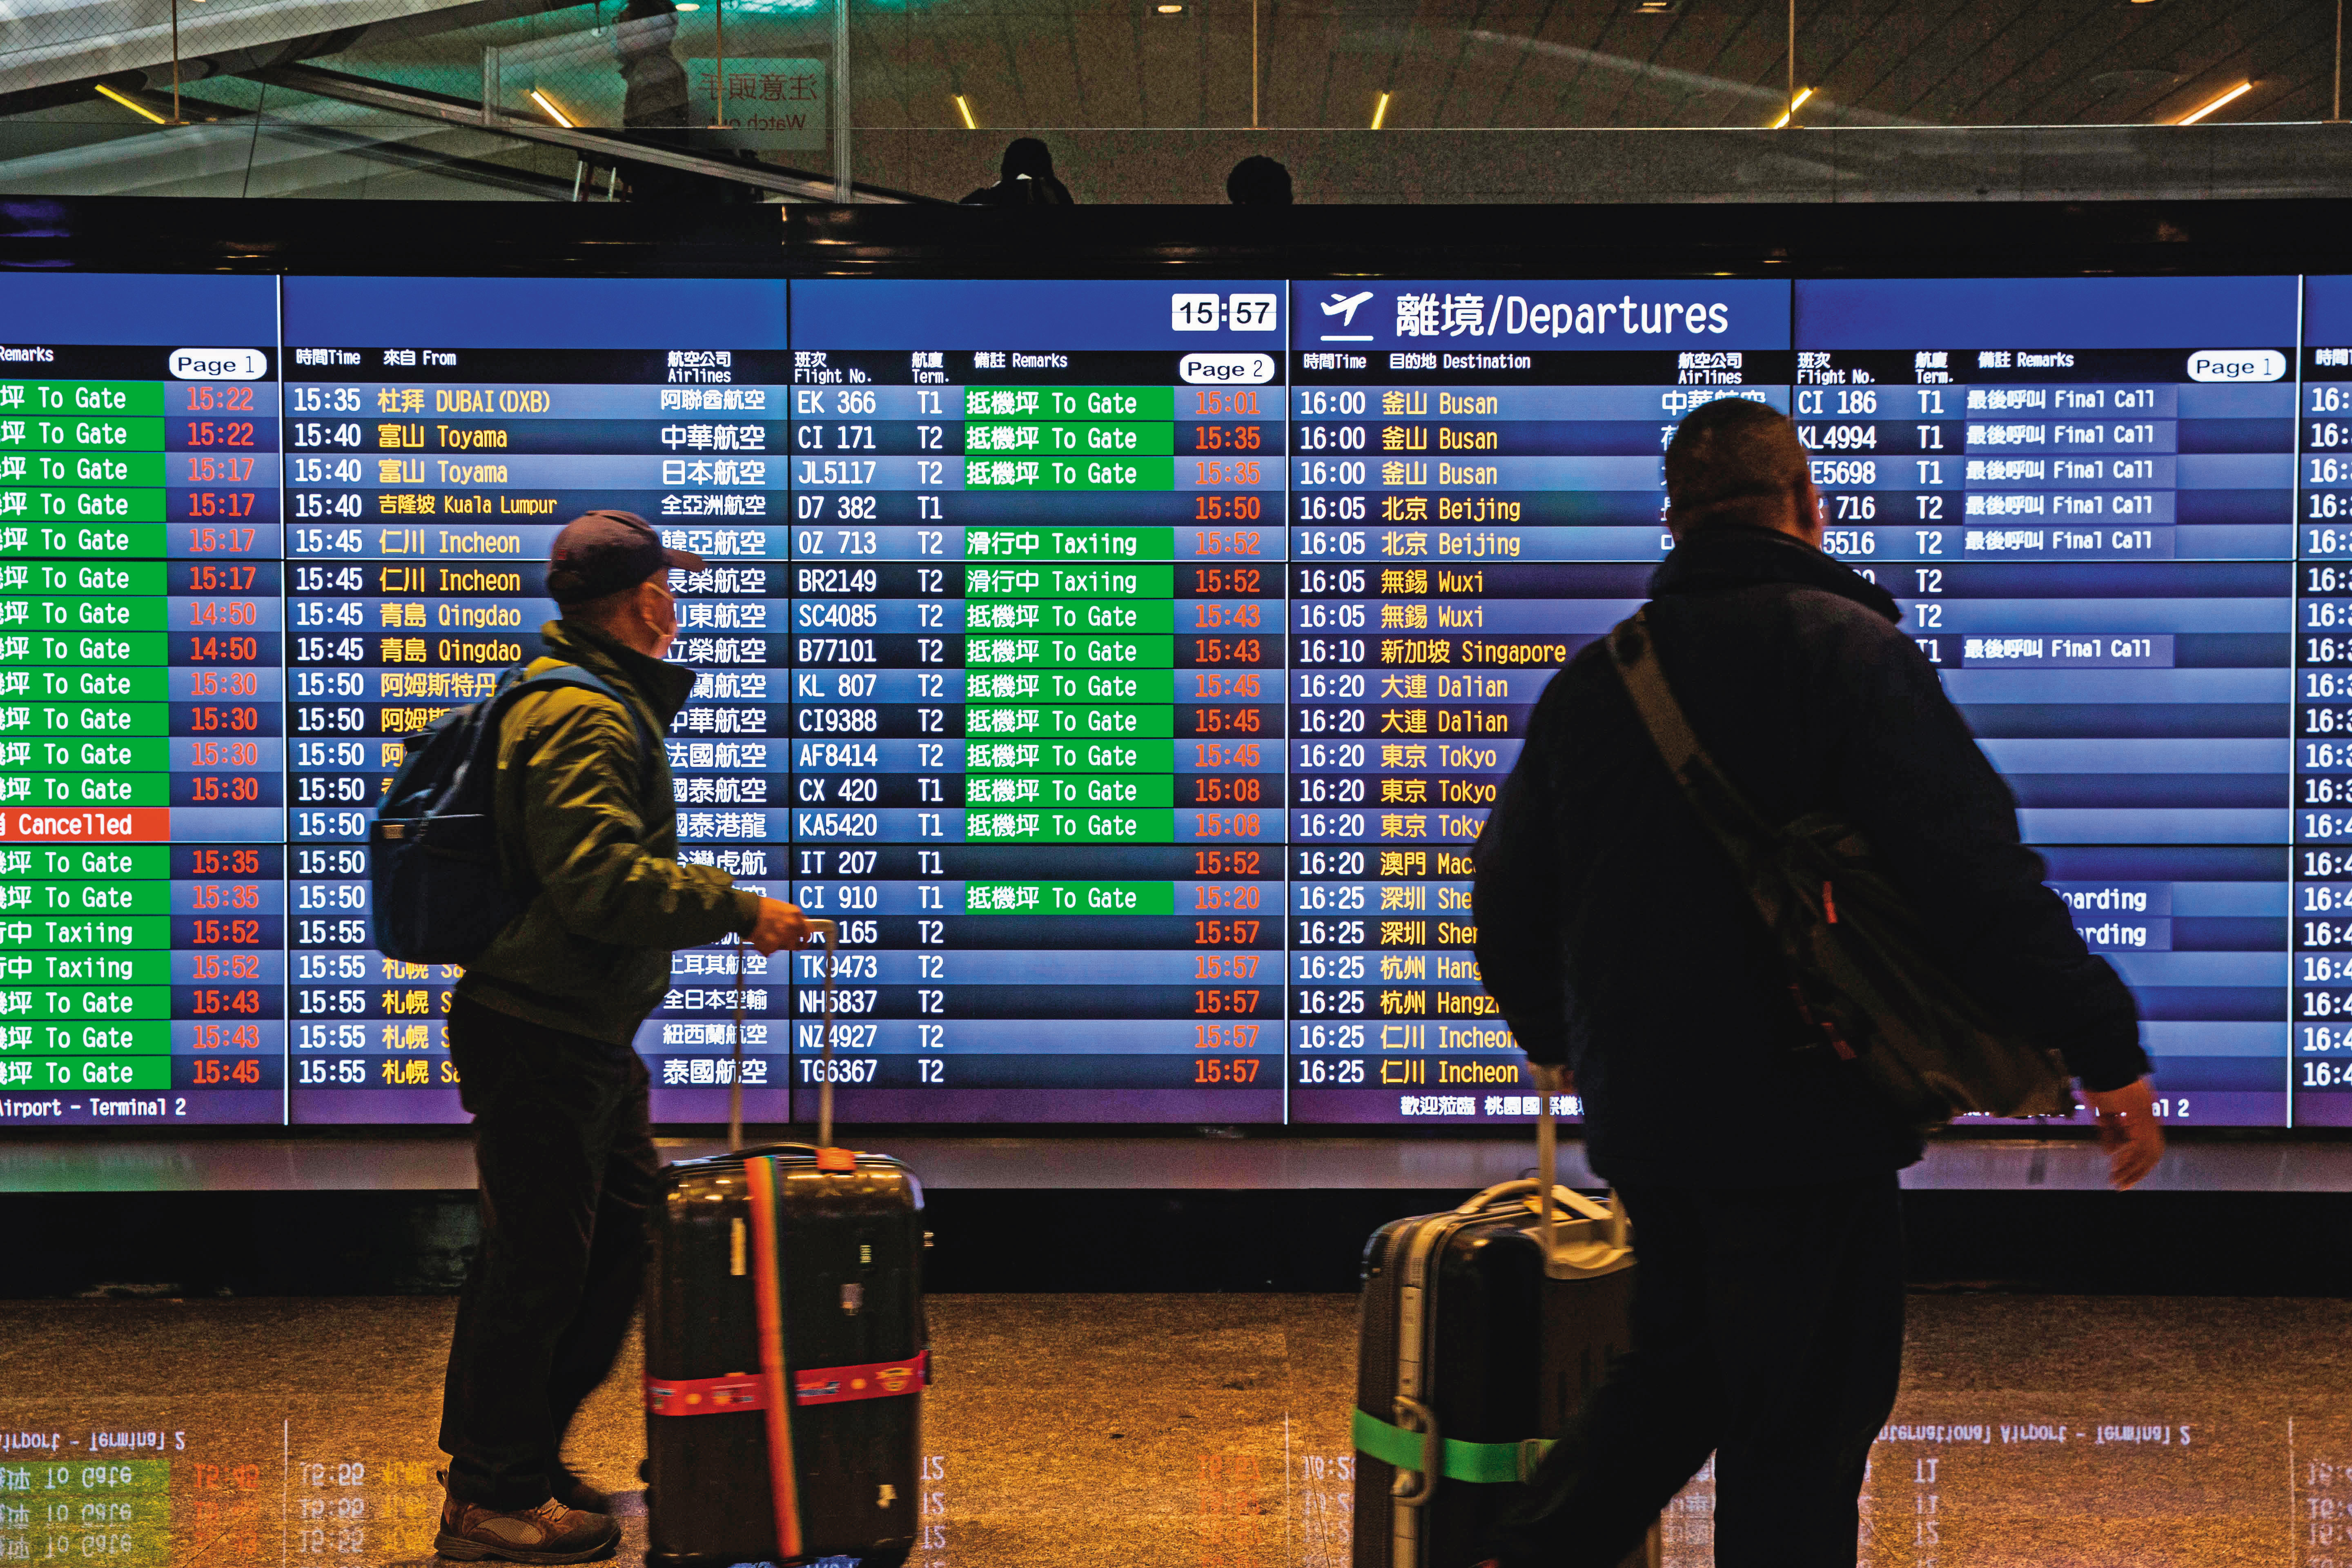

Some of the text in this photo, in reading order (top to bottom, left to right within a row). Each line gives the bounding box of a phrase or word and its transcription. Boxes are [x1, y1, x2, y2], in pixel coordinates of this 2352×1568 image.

[1180, 302, 1270, 324] 15:57
[1396, 293, 1728, 338] 離境/Departures
[178, 356, 254, 376] Page 1
[383, 349, 457, 366] 來自 From
[667, 350, 731, 367] 航空公司
[795, 351, 827, 368] 班次
[974, 352, 1067, 369] 備註 Remarks
[1390, 352, 1531, 369] 目的地 Destination
[1678, 352, 1742, 369] 航空公司
[1797, 352, 1831, 369] 班次
[1978, 351, 2074, 368] 備註 Remarks
[2197, 358, 2272, 378] Page 1
[668, 368, 731, 383] Airlines
[795, 368, 871, 385] Flight No.
[912, 368, 949, 383] Term.
[1188, 360, 1263, 380] Page 2
[1678, 370, 1742, 384] Airlines
[1797, 369, 1875, 385] Flight No.
[1915, 369, 1953, 383] Term.
[38, 386, 126, 409] To Gate
[187, 386, 254, 411] 15:22
[294, 388, 361, 411] 15:35
[377, 387, 550, 414] 杜拜 DUBAI(DXB)
[798, 390, 876, 414] EK 366
[917, 390, 943, 414] T1
[966, 390, 1137, 415] 抵機坪 To Gate
[1195, 391, 1261, 415] 15:01
[1301, 391, 1366, 414] 16:00
[1382, 390, 1497, 415] 釜山 Busan
[1798, 390, 1877, 414] CI 186
[1917, 390, 1944, 414] T1
[1967, 389, 2154, 410] 最後呼叫 Final Call
[294, 423, 361, 447] 15:40
[377, 423, 507, 450] 富山 Toyama
[662, 424, 765, 450] 中華航空
[798, 425, 876, 449] CI 171
[917, 425, 943, 449] T2
[1195, 426, 1261, 450] 15:35
[1798, 425, 1877, 449] KL4994
[188, 457, 254, 481] 15:17
[663, 459, 766, 486] 日本航空
[798, 461, 876, 484] JL5117
[378, 494, 557, 515] 吉隆坡 Kuala Lumpur
[661, 494, 766, 516] 全亞洲航空
[798, 496, 876, 519] D7 382
[1196, 496, 1261, 520] 15:50
[1301, 496, 1365, 519] 16:05
[1381, 496, 1520, 522] 北京 Beijing
[296, 529, 362, 552] 15:45
[379, 528, 520, 555] 仁川 Incheon
[799, 531, 877, 554] OZ 713
[967, 531, 1137, 556] 滑行中 Taxiing
[1195, 531, 1261, 555] 15:52
[799, 569, 876, 592] BR2149
[1381, 568, 1483, 594] 無錫 Wuxi
[190, 601, 256, 625] 14:50
[379, 602, 521, 628] 青島 Qingdao
[799, 604, 877, 627] SC4085
[799, 639, 877, 662] B77101
[1195, 639, 1261, 662] 15:43
[1300, 639, 1365, 662] 16:10
[1381, 639, 1566, 664] 新加坡 Singapore
[381, 672, 497, 698] 阿姆斯特丹
[799, 674, 877, 697] KL 807
[1381, 673, 1508, 698] 大連 Dalian
[191, 707, 258, 731] 15:30
[799, 708, 877, 731] CI9388
[664, 742, 766, 768] 法國航空
[800, 744, 878, 766] AF8414
[1381, 743, 1497, 769] 東京 Tokyo
[800, 778, 877, 802] CX 420
[1195, 778, 1260, 802] 15:08
[19, 813, 132, 835] Cancelled
[800, 813, 877, 836] KA5420
[299, 850, 365, 873] 15:50
[801, 851, 877, 873] IT 207
[1380, 851, 1426, 876] 澳門
[1299, 886, 1365, 909] 16:25
[1380, 886, 1425, 911] 深圳
[45, 922, 132, 945] Taxiing
[193, 920, 259, 944] 15:52
[800, 955, 878, 978] TK9473
[1380, 955, 1425, 980] 杭州
[663, 989, 768, 1010] 全日本空輸
[800, 990, 877, 1013] NH5837
[800, 1025, 878, 1047] NZ4927
[193, 1059, 260, 1084] 15:45
[299, 1060, 365, 1083] 15:55
[382, 1059, 429, 1085] 札幌
[663, 1058, 767, 1084] 泰國航空
[800, 1059, 877, 1082] TG6367
[1195, 1059, 1260, 1083] 15:57
[90, 1098, 166, 1116] Terminal
[176, 1098, 187, 1115] 2
[2178, 1098, 2189, 1117] 2
